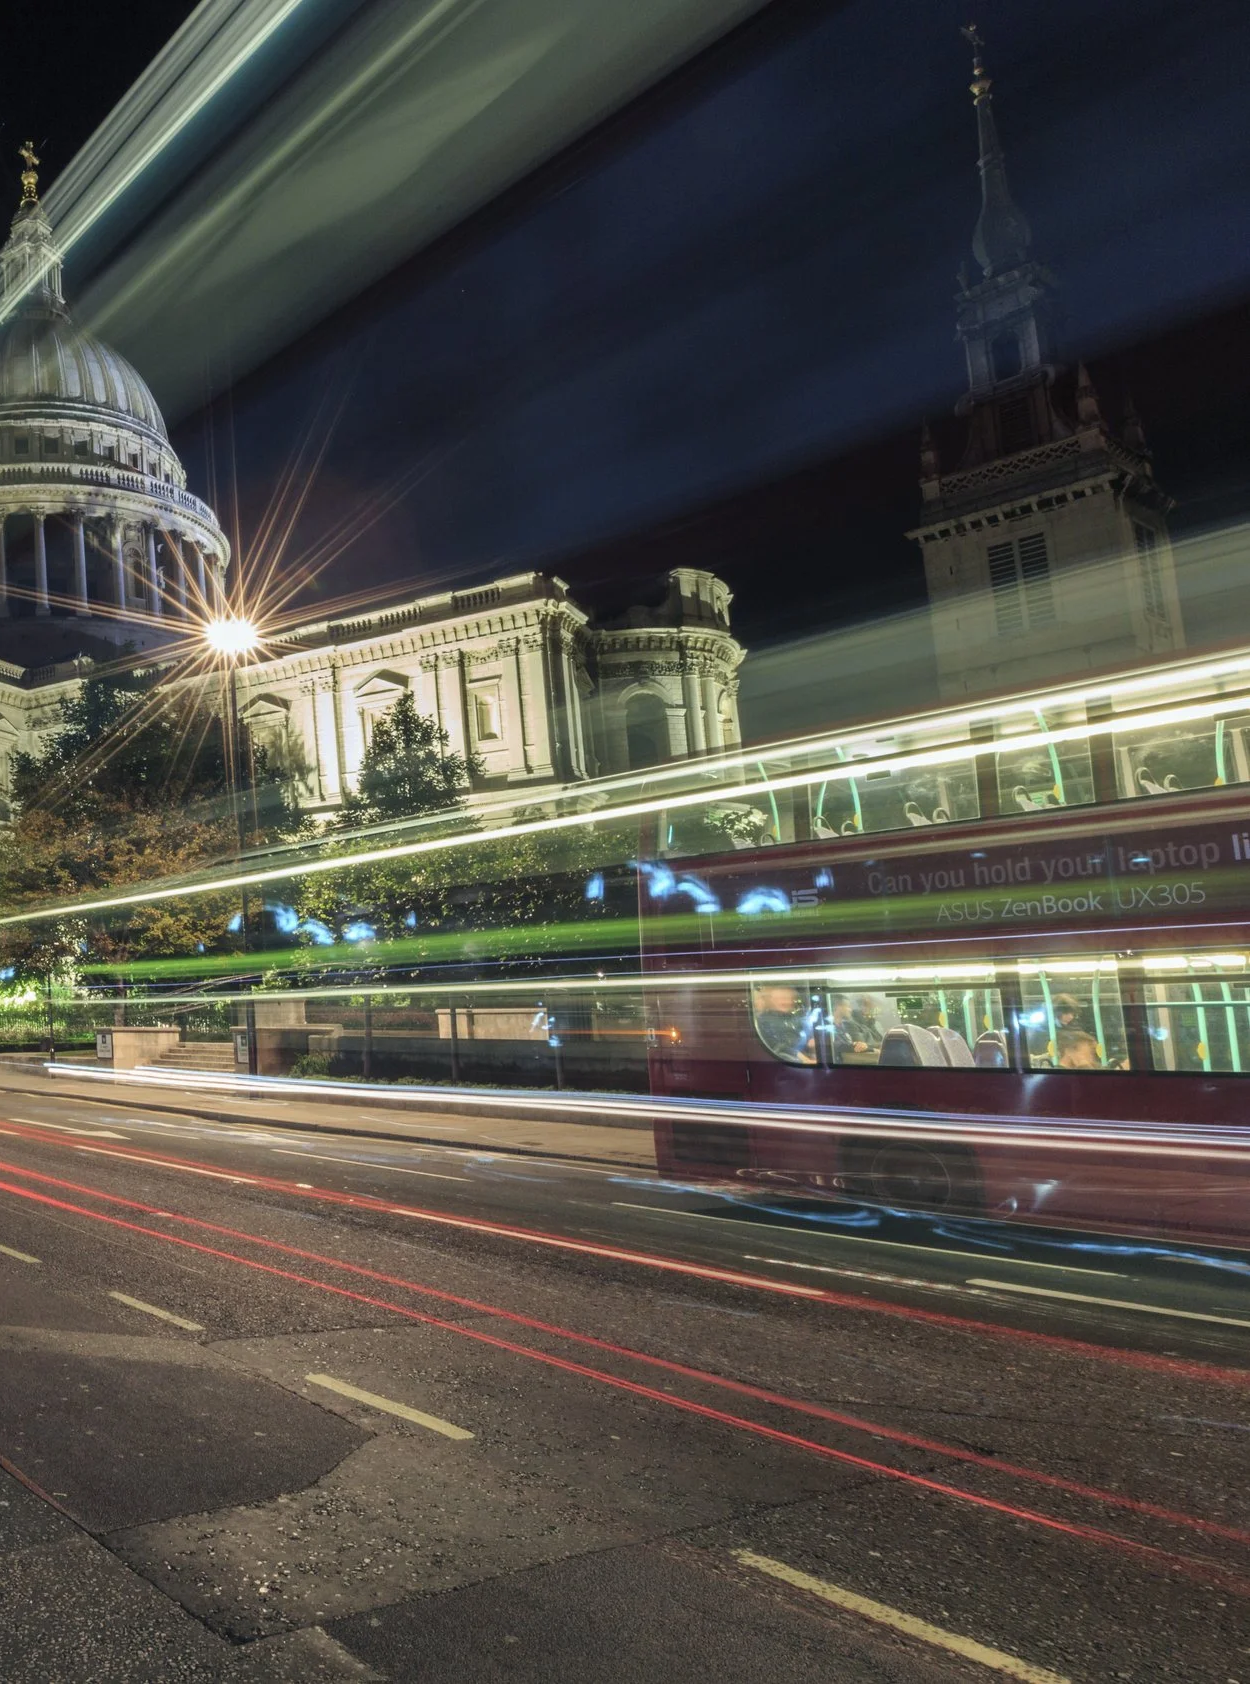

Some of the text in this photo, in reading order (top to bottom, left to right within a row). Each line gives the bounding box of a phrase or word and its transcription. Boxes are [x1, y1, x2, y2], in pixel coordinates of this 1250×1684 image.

[867, 871, 912, 894] Can
[920, 867, 966, 895] you
[973, 856, 1031, 885] hold
[1040, 852, 1104, 885] your
[1117, 840, 1221, 875] laptop
[937, 881, 1206, 922] ASUS ZenBook UX305
